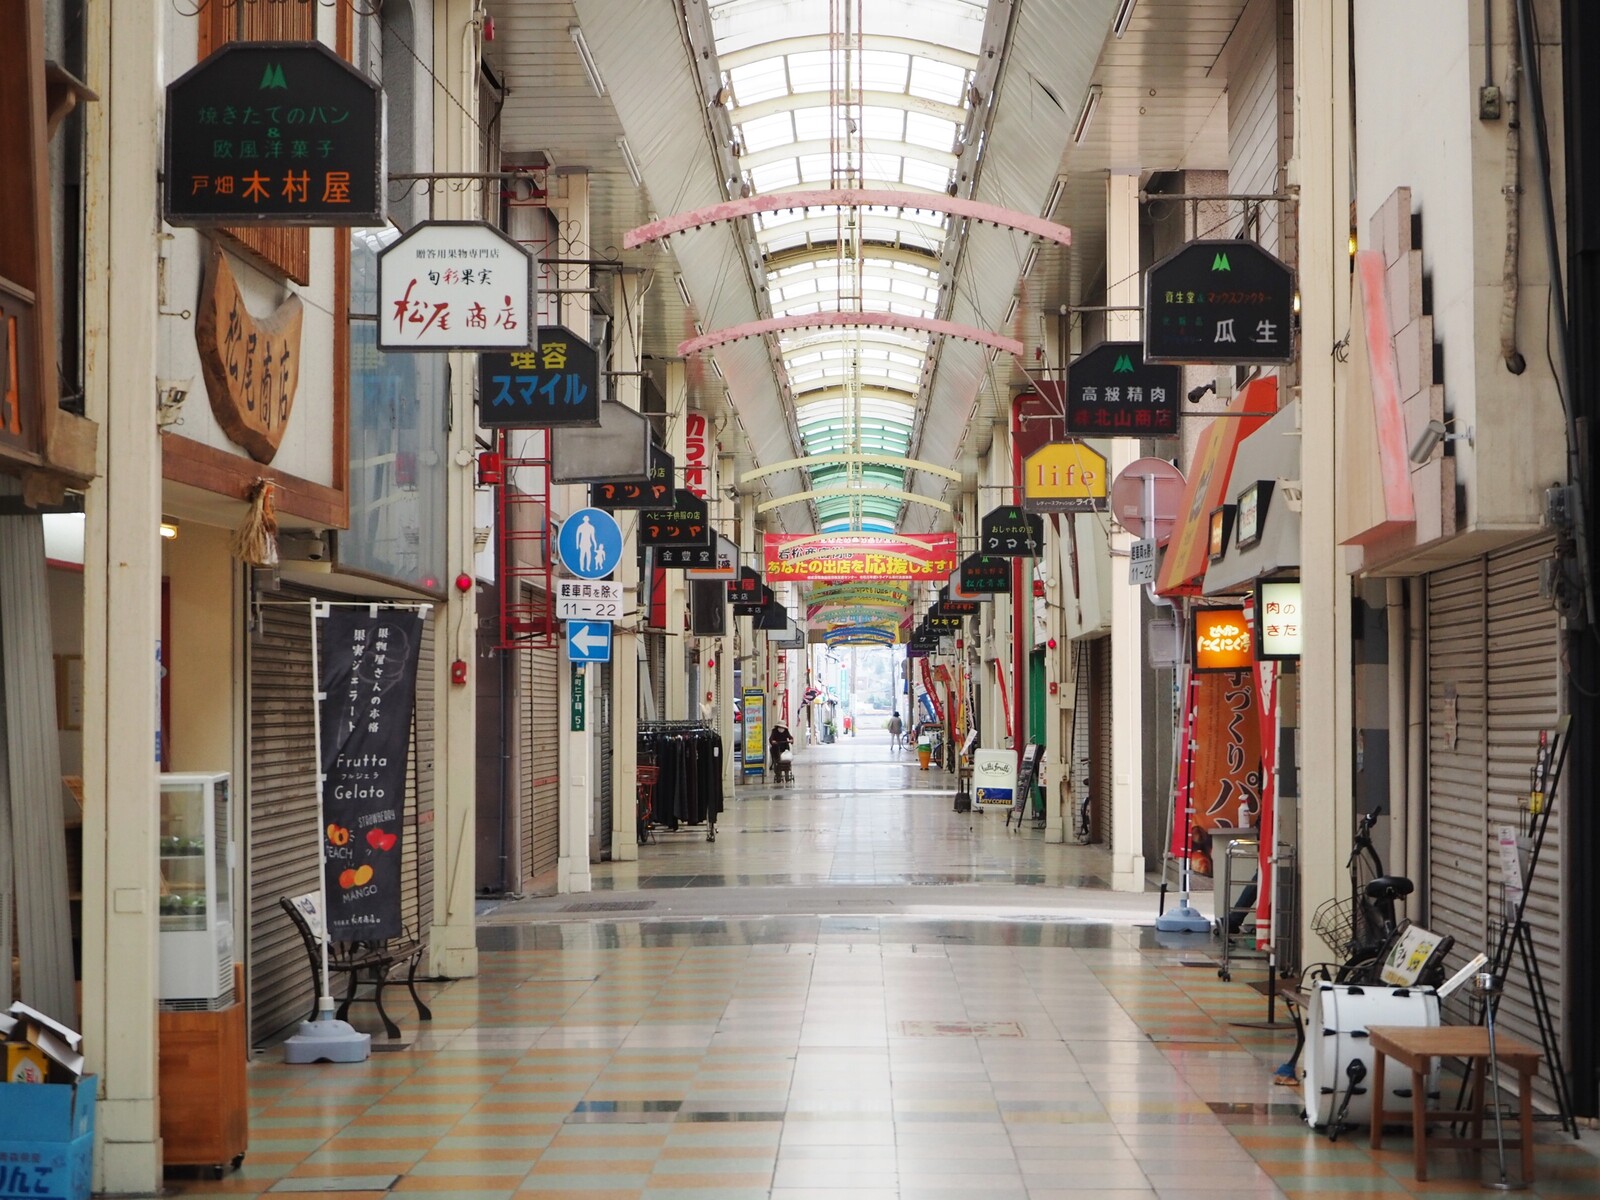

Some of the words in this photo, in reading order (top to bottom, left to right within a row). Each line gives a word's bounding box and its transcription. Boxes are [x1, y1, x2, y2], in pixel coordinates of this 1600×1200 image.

[267, 127, 281, 138] &
[213, 139, 335, 160] 欧風洋菓子
[415, 248, 500, 260] 贈答用果物専門店
[427, 268, 493, 286] 旬彩果実
[393, 278, 519, 340] 松尾商店
[1213, 318, 1278, 344] 瓜生
[510, 342, 567, 370] 理容
[491, 372, 588, 407] スマイル
[1082, 386, 1166, 403] 高級精肉
[1036, 464, 1097, 487] life
[561, 583, 619, 599] 軽車両を除く
[1266, 602, 1297, 615] 肉の
[1266, 623, 1298, 637] きた
[336, 753, 388, 768] Frutta
[334, 783, 385, 800] Gelato
[342, 883, 378, 904] MANGO
